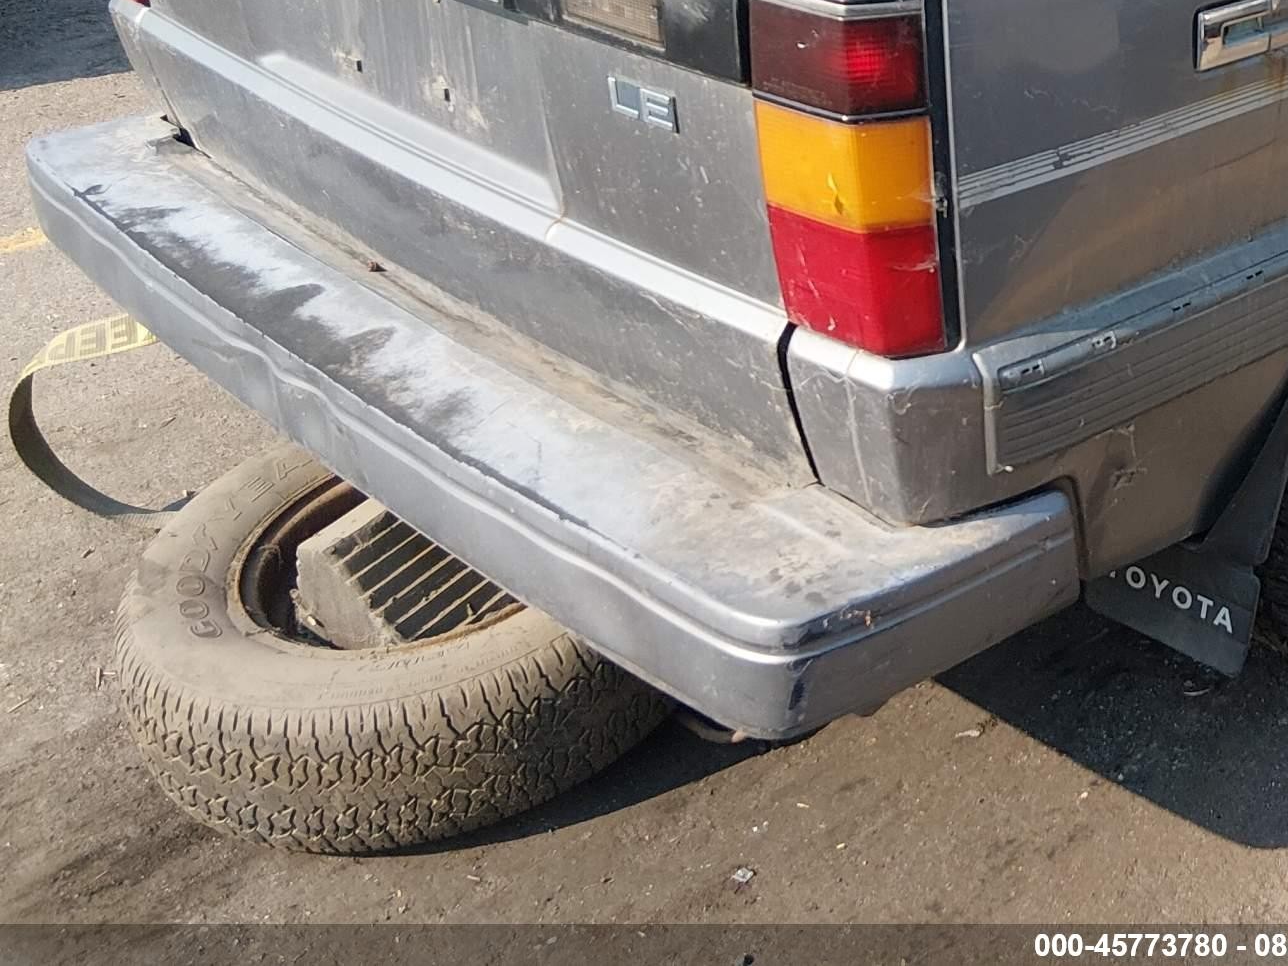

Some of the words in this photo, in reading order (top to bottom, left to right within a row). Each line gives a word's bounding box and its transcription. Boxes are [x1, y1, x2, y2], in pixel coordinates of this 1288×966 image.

[607, 76, 673, 131] LE
[176, 458, 314, 639] GOODYEA
[1110, 565, 1233, 634] OYOTA
